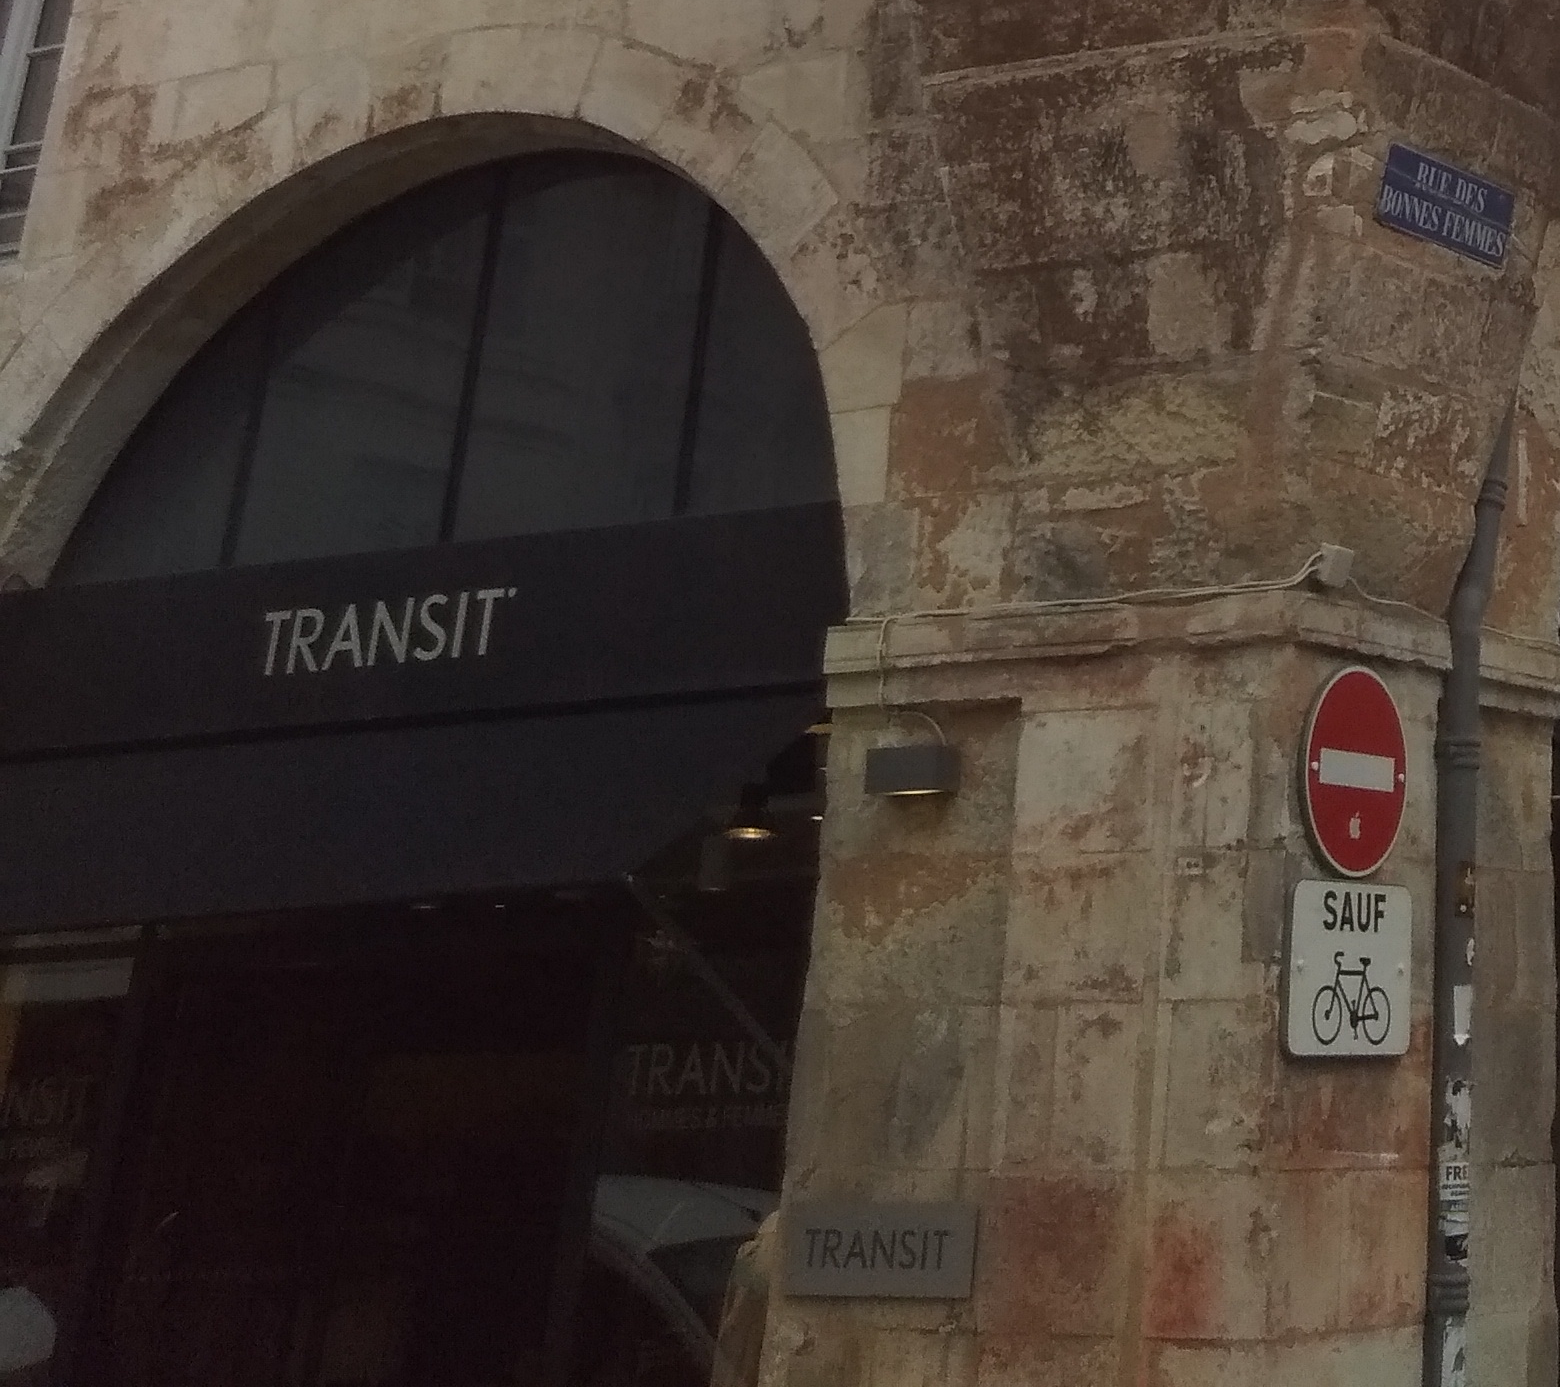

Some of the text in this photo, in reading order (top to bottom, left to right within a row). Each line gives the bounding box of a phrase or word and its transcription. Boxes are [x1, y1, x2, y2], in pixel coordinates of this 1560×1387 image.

[1416, 162, 1489, 213] RUE DES
[1381, 185, 1507, 257] BONNES FEMMES
[263, 588, 506, 677] TRANSIT
[1322, 889, 1386, 934] SAUF
[627, 1040, 788, 1097] TRANSI
[805, 1228, 950, 1271] TRANSIT
